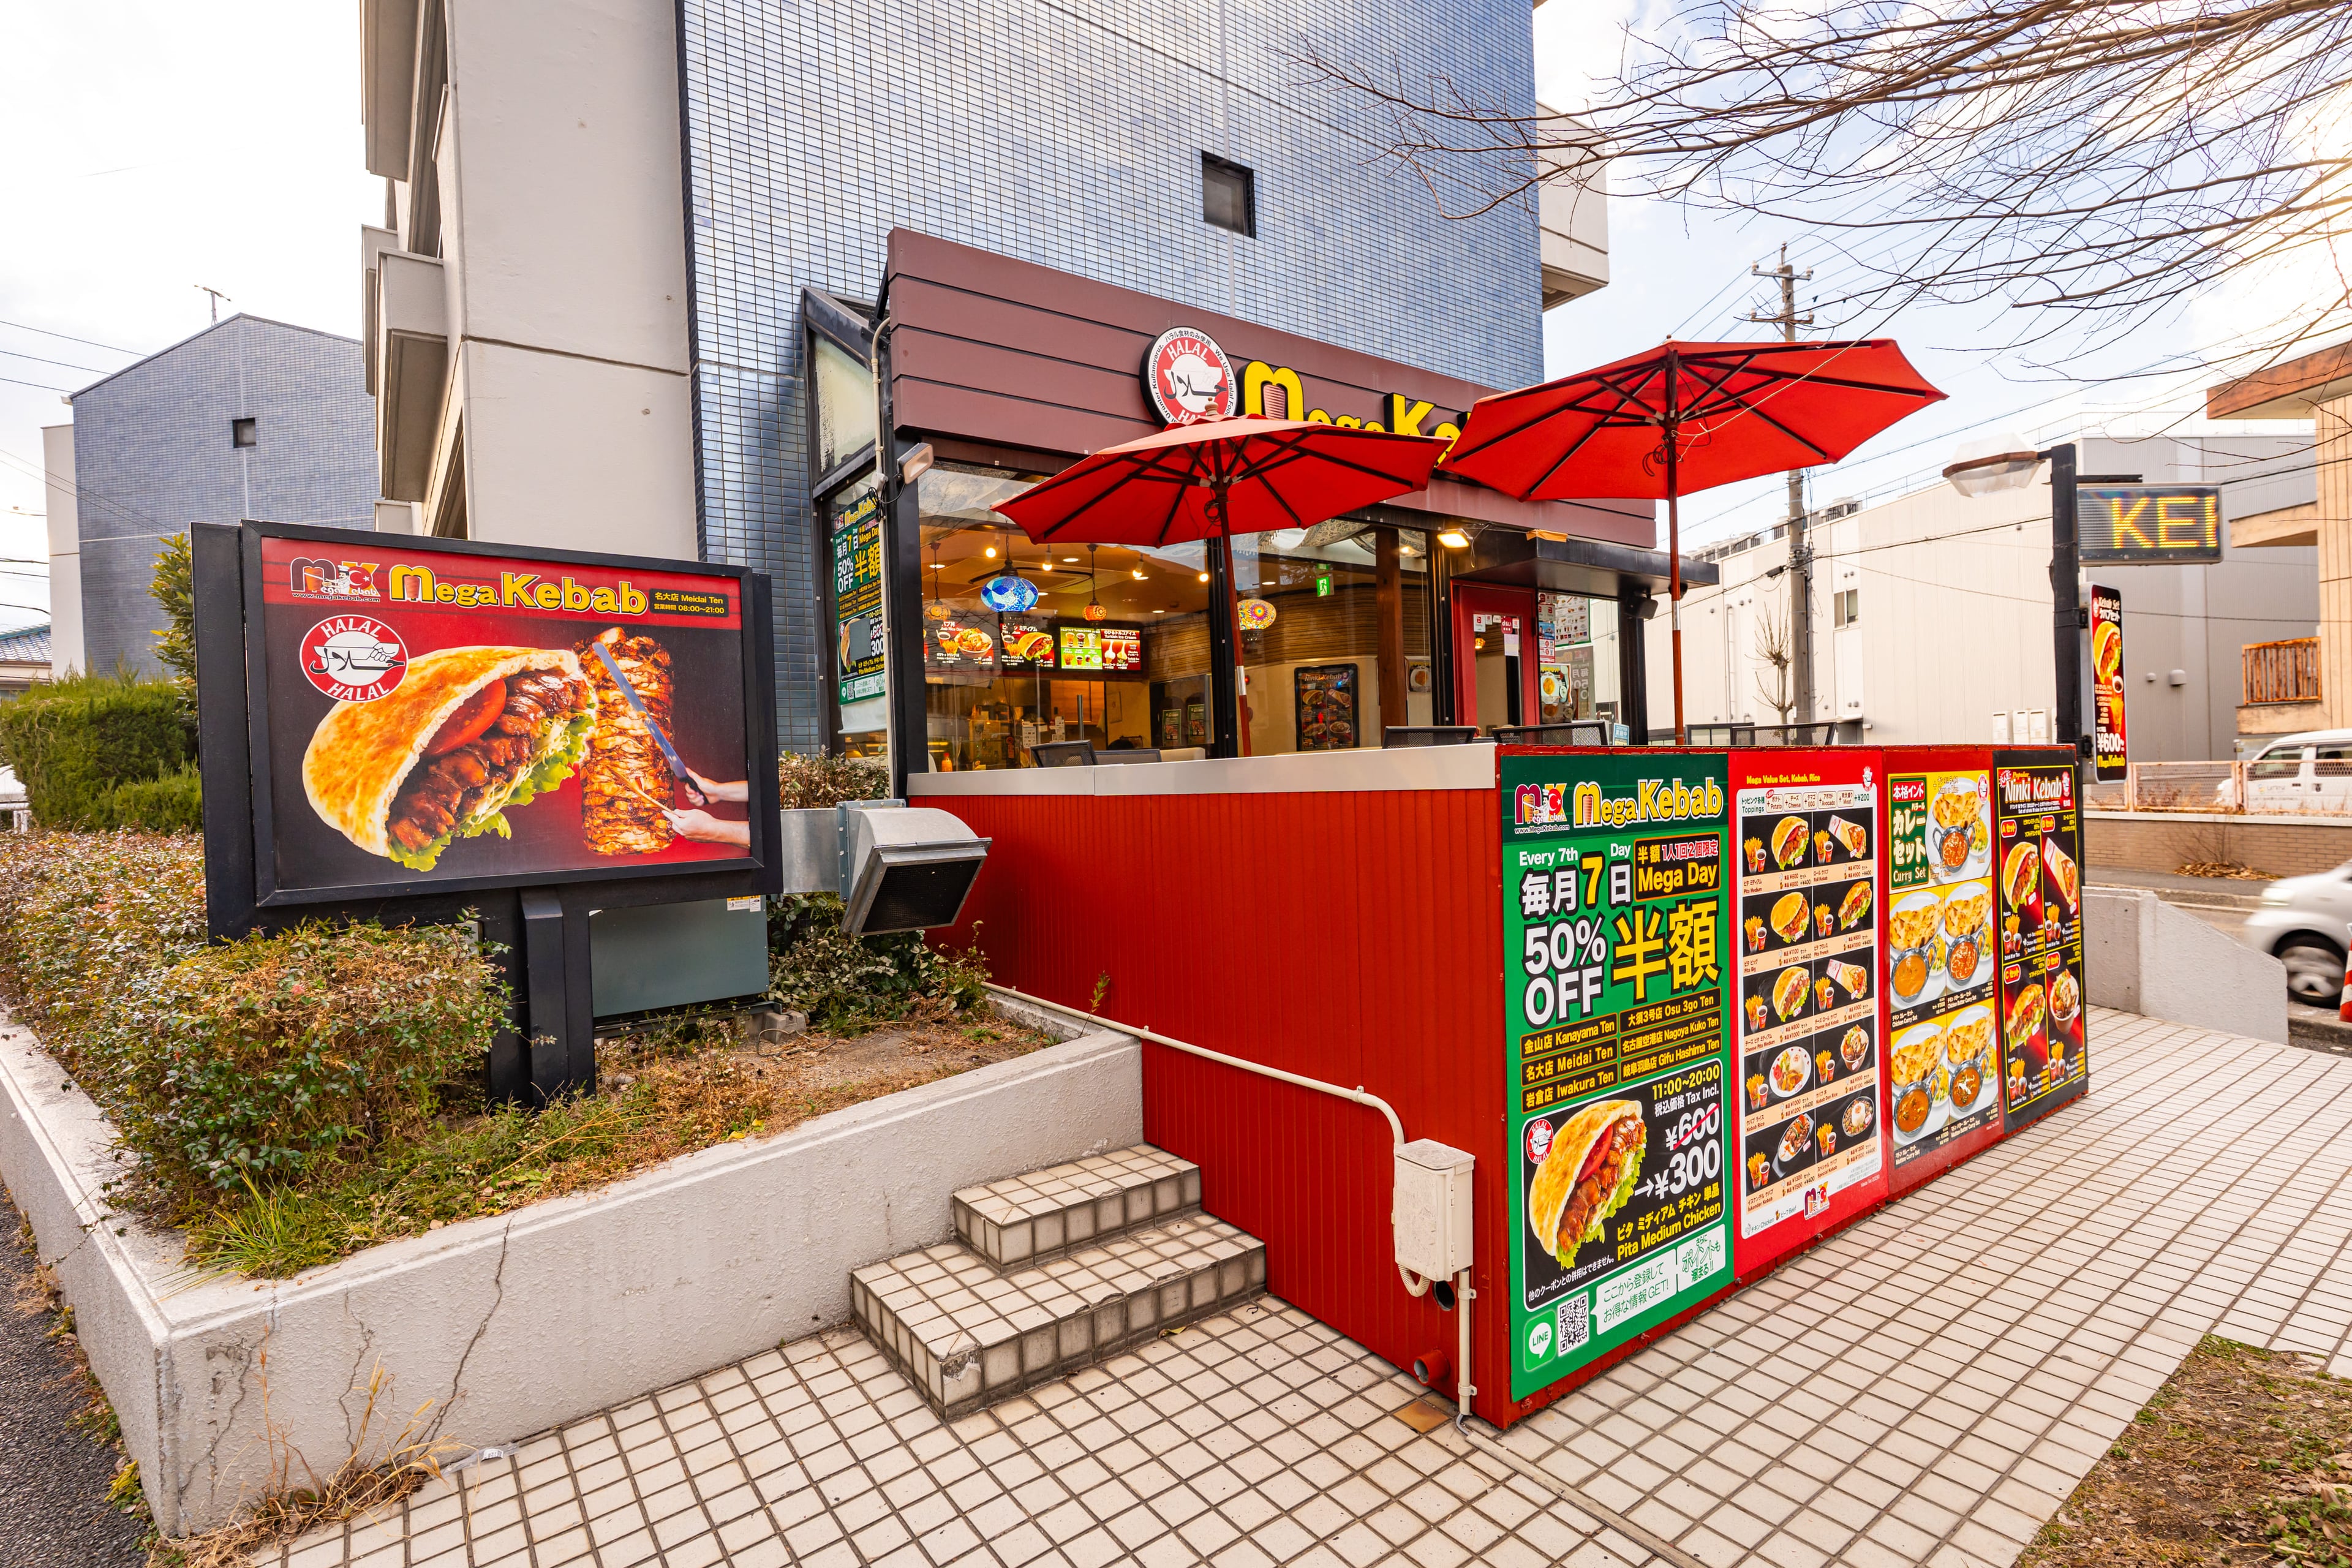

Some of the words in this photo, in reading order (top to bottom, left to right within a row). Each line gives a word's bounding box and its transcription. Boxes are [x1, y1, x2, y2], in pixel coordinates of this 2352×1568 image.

[1166, 339, 1208, 361] HALAL
[1215, 349, 1223, 361] We
[859, 531, 871, 545] Mega
[837, 556, 854, 577] 50%
[501, 572, 648, 616] Kebab
[837, 571, 853, 594] OFF
[292, 592, 380, 603] www.megakebab.com
[655, 592, 679, 601] 名大店
[681, 595, 707, 603] Meidai
[320, 618, 382, 638] HALAL
[327, 682, 390, 701] HALAL
[1746, 775, 1762, 785] Mega
[1763, 775, 1778, 783] Value
[1779, 774, 1790, 783] Set,
[1809, 773, 1820, 782] Rice
[1893, 782, 1924, 799] 本格インド
[2005, 776, 2030, 803] Ninki
[2034, 776, 2062, 801] Kebab
[1574, 781, 1638, 829] Mega
[1638, 777, 1724, 821] Kebab
[1742, 805, 1765, 814] Toppings
[1514, 824, 1570, 834] www.MegaKebab.com
[1893, 809, 1926, 836] カレー
[1520, 851, 1555, 866] Every
[1558, 848, 1578, 861] 7th
[1610, 843, 1630, 859] Day
[1893, 837, 1926, 865] セット
[1638, 865, 1683, 892] Mega
[1687, 861, 1718, 887] Day
[1893, 870, 1912, 883] Curry
[1915, 866, 1926, 879] Set
[1525, 916, 1607, 975] 50%
[1613, 900, 1719, 1000] 半額
[1525, 966, 1603, 1025] OFF
[1627, 1007, 1662, 1027] 大須3号店
[1665, 1003, 1681, 1017] Osu
[1683, 998, 1698, 1014] 3go
[1700, 994, 1714, 1008] Ten
[1524, 1035, 1553, 1055] 金山店
[1555, 1024, 1599, 1045] Kanayama
[1599, 1019, 1615, 1033] Ten
[1623, 1031, 1663, 1054] 名古屋空港店
[1664, 1024, 1689, 1042] Nagoya
[1689, 1019, 1706, 1033] Kuko
[1707, 1016, 1719, 1029] Ten
[1526, 1060, 1554, 1082] 名大店
[1558, 1049, 1593, 1072] Meidai
[1595, 1045, 1613, 1060] Ten
[1623, 1056, 1657, 1079] 岐阜羽島店
[1658, 1052, 1675, 1068] Gifu
[1675, 1042, 1706, 1062] Hashima
[1706, 1038, 1720, 1051] Ten
[1526, 1088, 1553, 1108] 岩倉店
[1557, 1077, 1596, 1099] Iwakura
[1597, 1070, 1615, 1084] Ten
[1654, 1096, 1685, 1118] 税込価格
[1686, 1089, 1702, 1106] Tax
[1702, 1083, 1719, 1099] Incl.
[1531, 1121, 1547, 1133] HALAL
[1665, 1102, 1720, 1152] ¥600
[1654, 1139, 1721, 1200] ¥300
[1617, 1221, 1634, 1242] ピタ
[1637, 1203, 1676, 1231] ミディアム
[1678, 1192, 1702, 1211] チキン
[1704, 1182, 1719, 1201] 単品
[1760, 1218, 1774, 1228] Chicken
[1617, 1242, 1638, 1261] Pita
[1641, 1221, 1681, 1250] Medium
[1683, 1202, 1721, 1230] Chicken
[1604, 1262, 1664, 1303] ここから登録して
[1532, 1330, 1549, 1347] LINE
